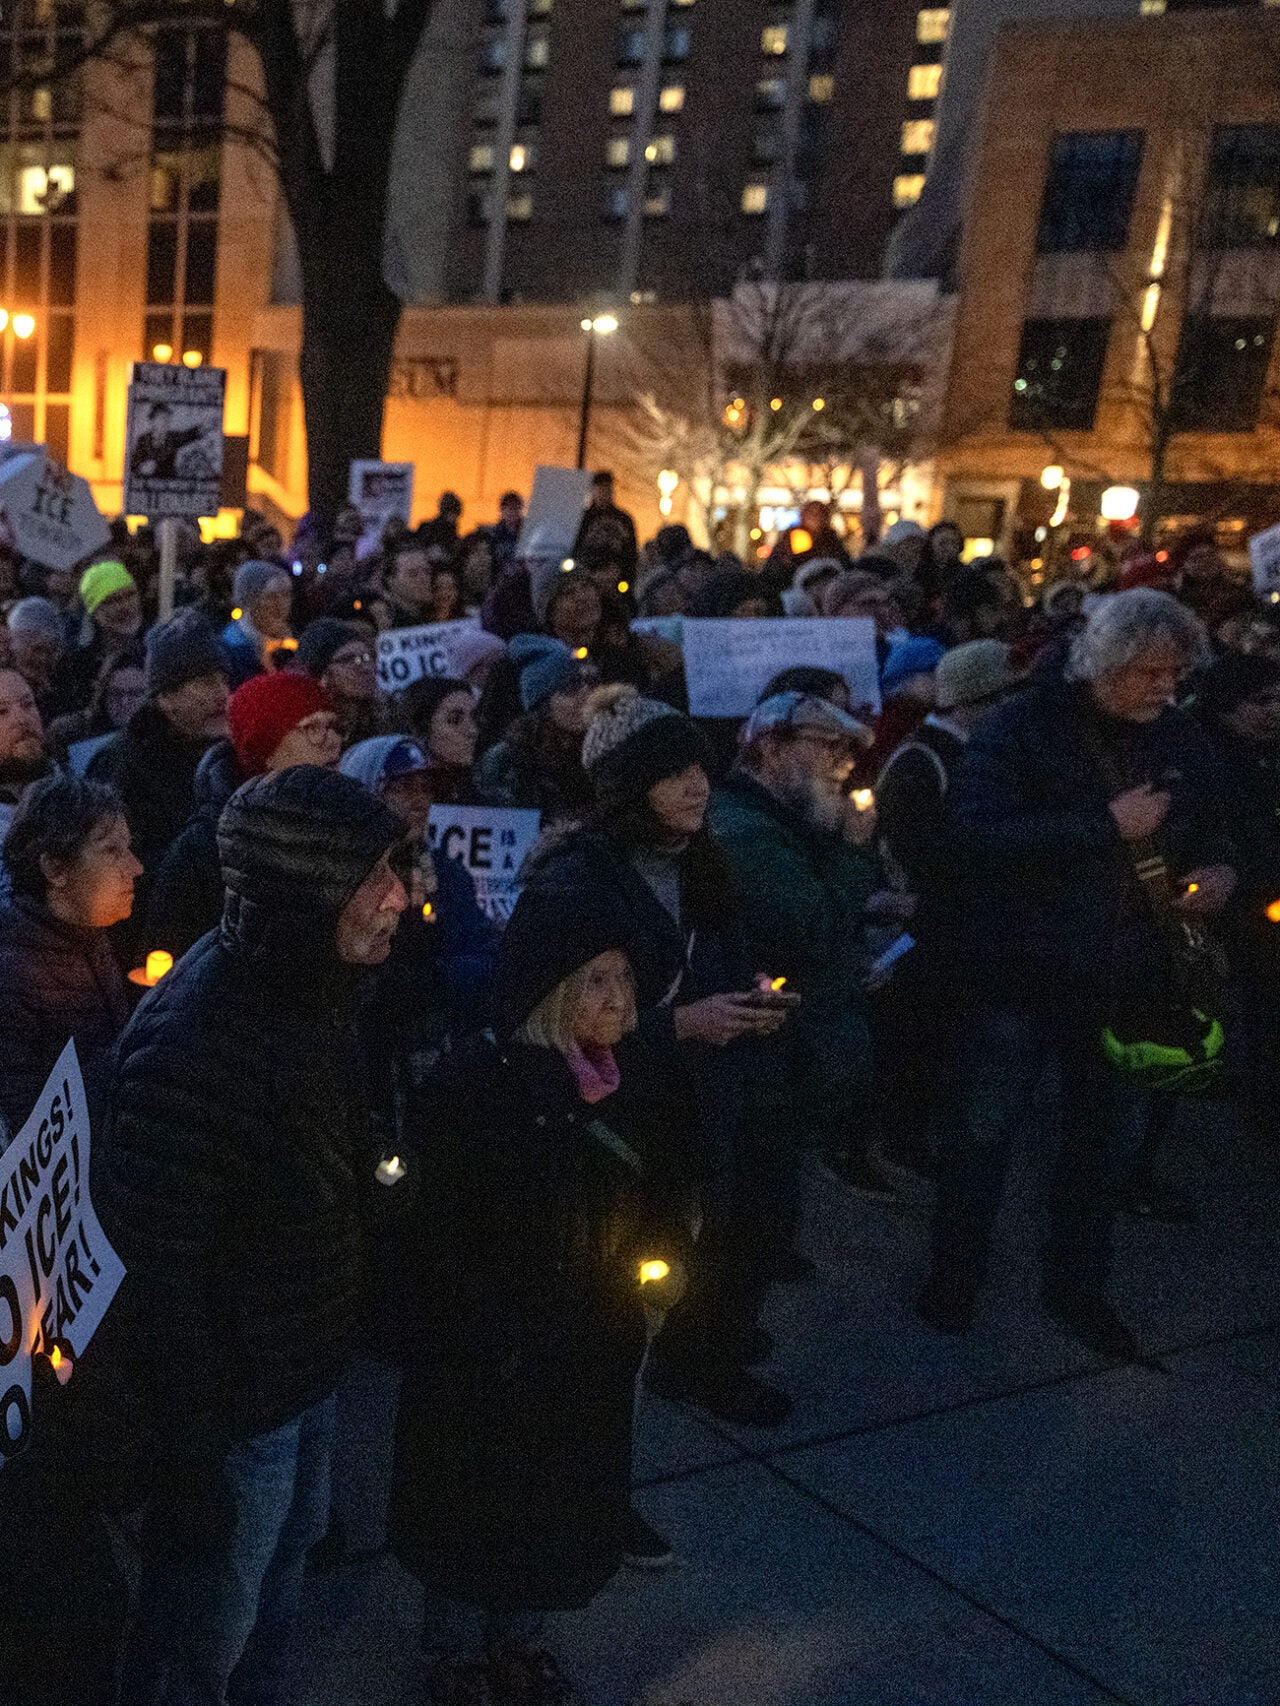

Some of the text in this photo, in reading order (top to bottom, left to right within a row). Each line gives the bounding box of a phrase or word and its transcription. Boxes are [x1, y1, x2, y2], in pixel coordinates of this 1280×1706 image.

[31, 484, 76, 527] ICE
[419, 650, 449, 675] IC
[500, 829, 517, 847] IS
[502, 854, 514, 870] A
[25, 1139, 81, 1301] ICE!
